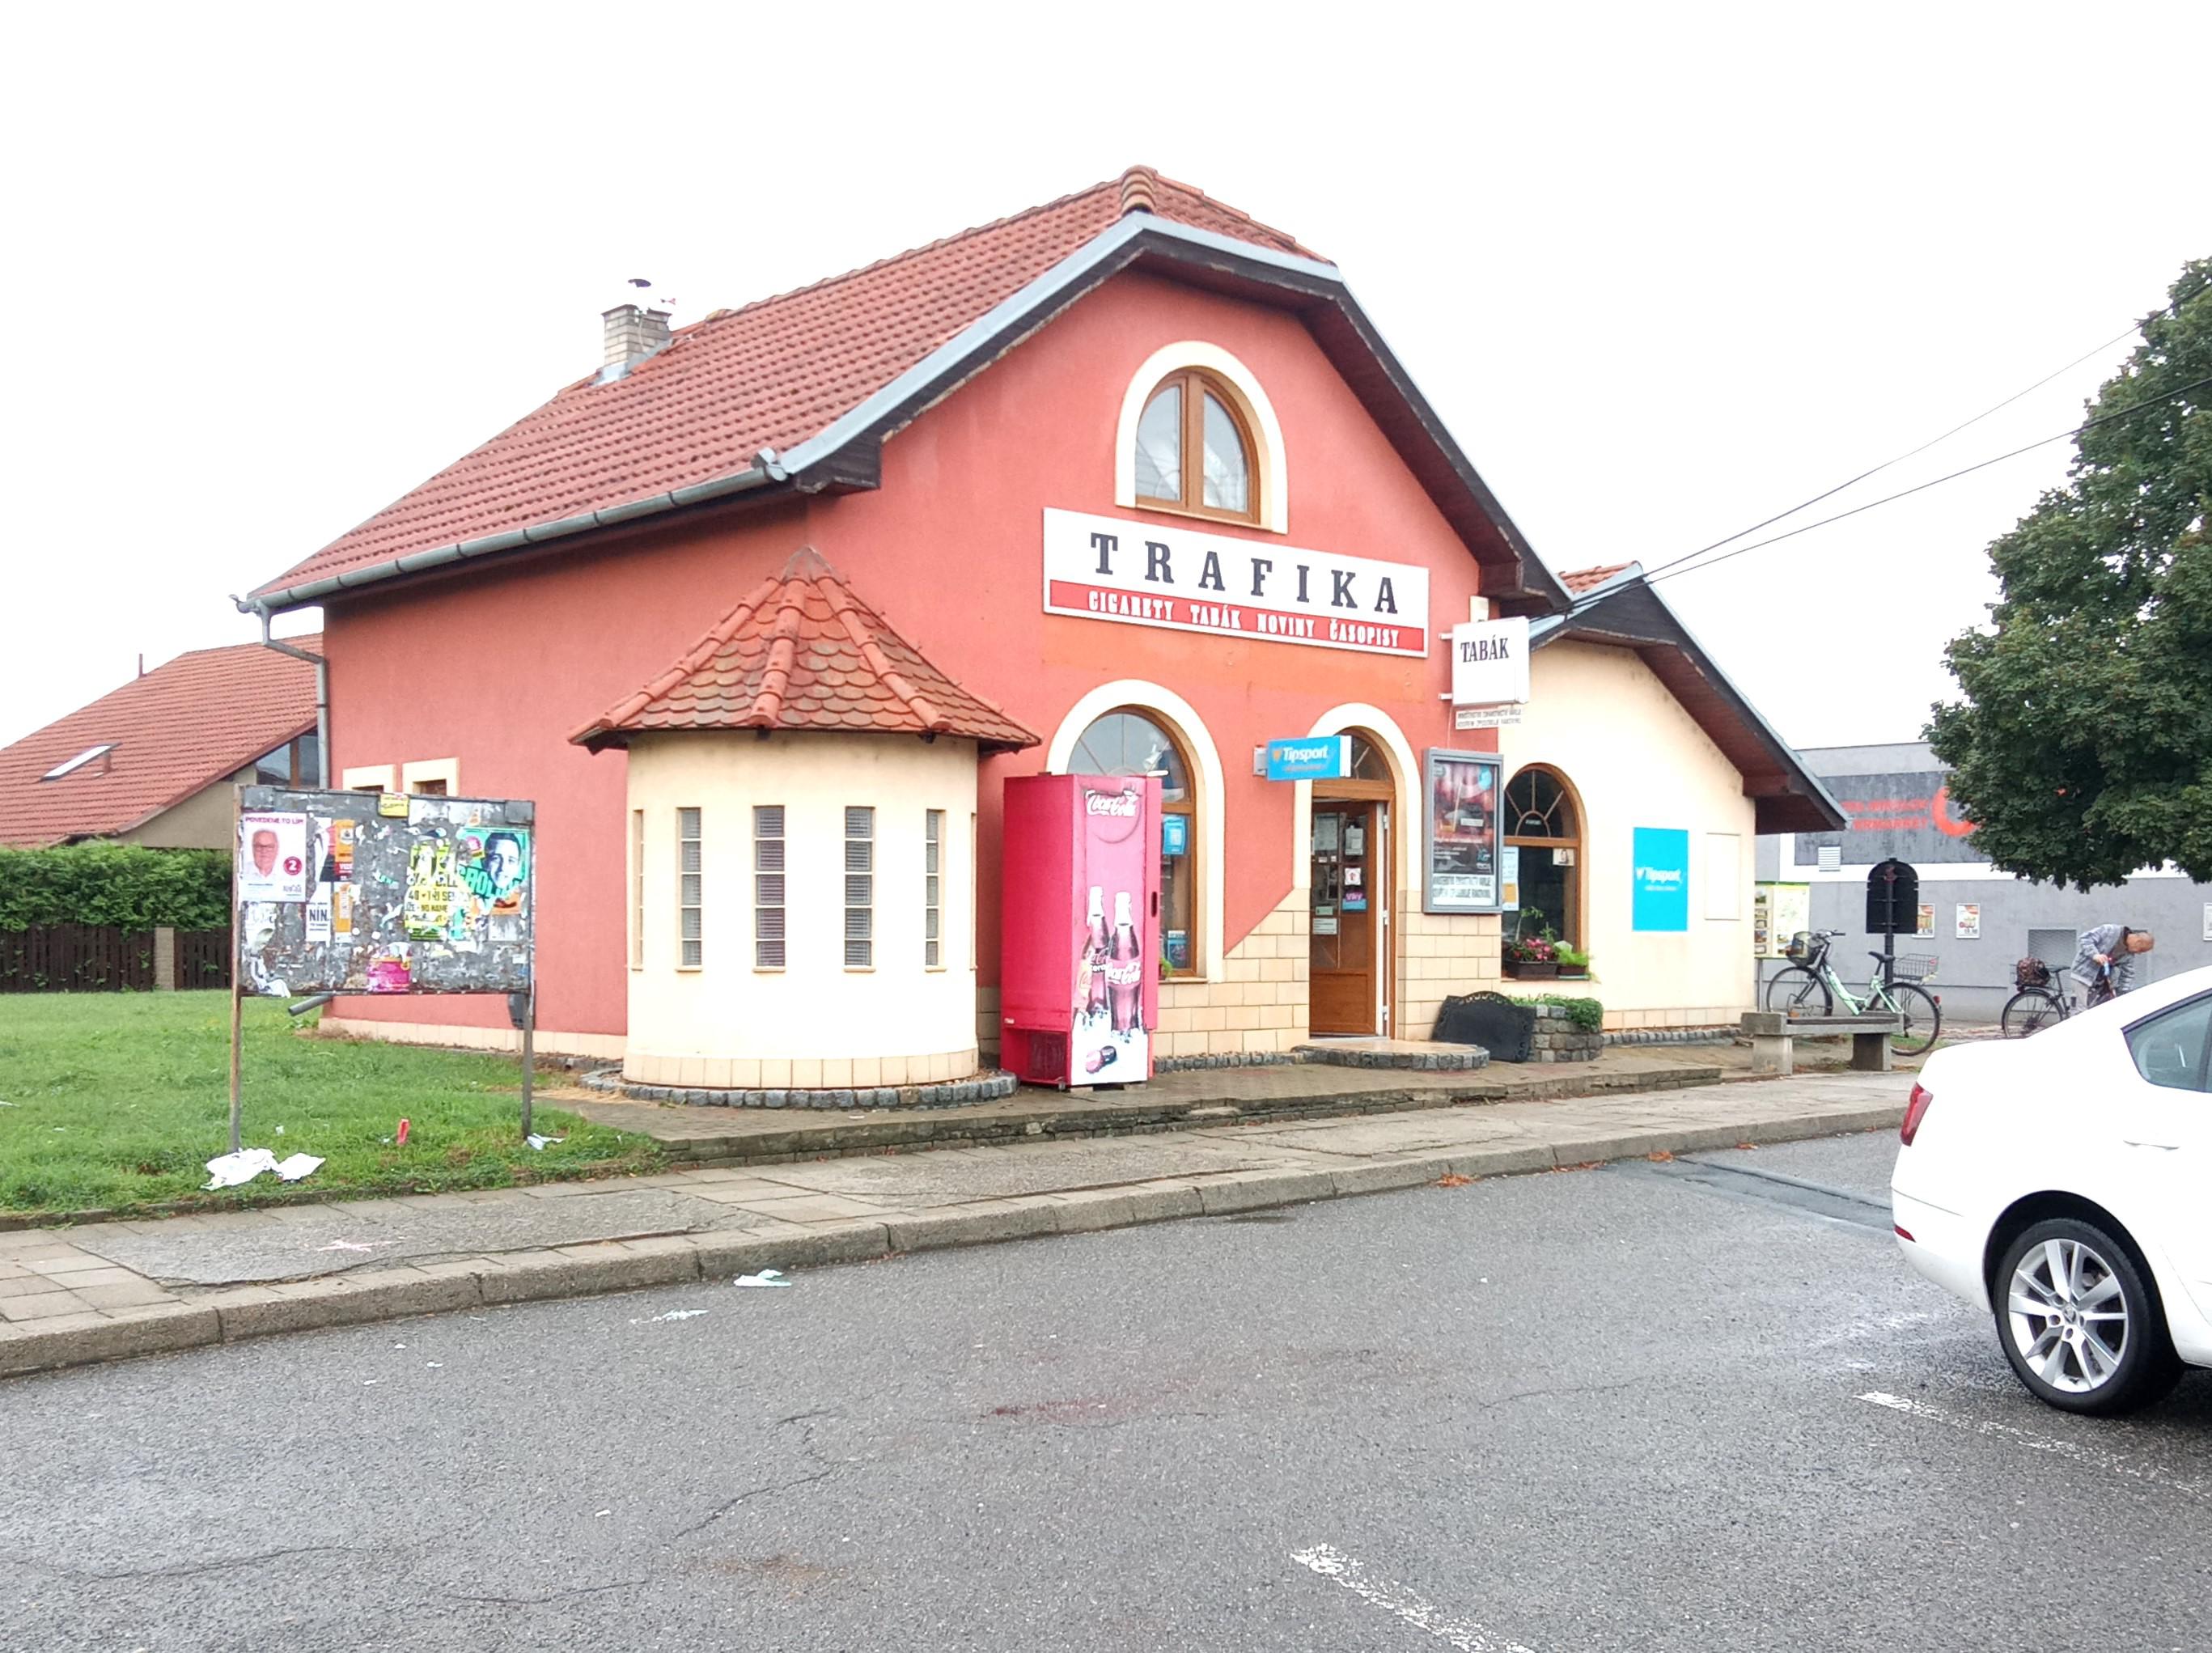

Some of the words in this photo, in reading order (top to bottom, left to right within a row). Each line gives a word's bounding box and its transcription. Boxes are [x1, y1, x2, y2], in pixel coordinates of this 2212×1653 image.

[1091, 532, 1398, 614] TRAFIKA
[1089, 591, 1174, 621] CIGARETY
[1190, 604, 1241, 629] TABÁK
[1256, 613, 1315, 638] NOVINY
[1329, 618, 1399, 647] ČASOPISY
[1460, 634, 1509, 663] TABÁK
[1283, 744, 1328, 763] Tipsport
[288, 859, 298, 871] 2
[1645, 867, 1682, 884] Tipsport
